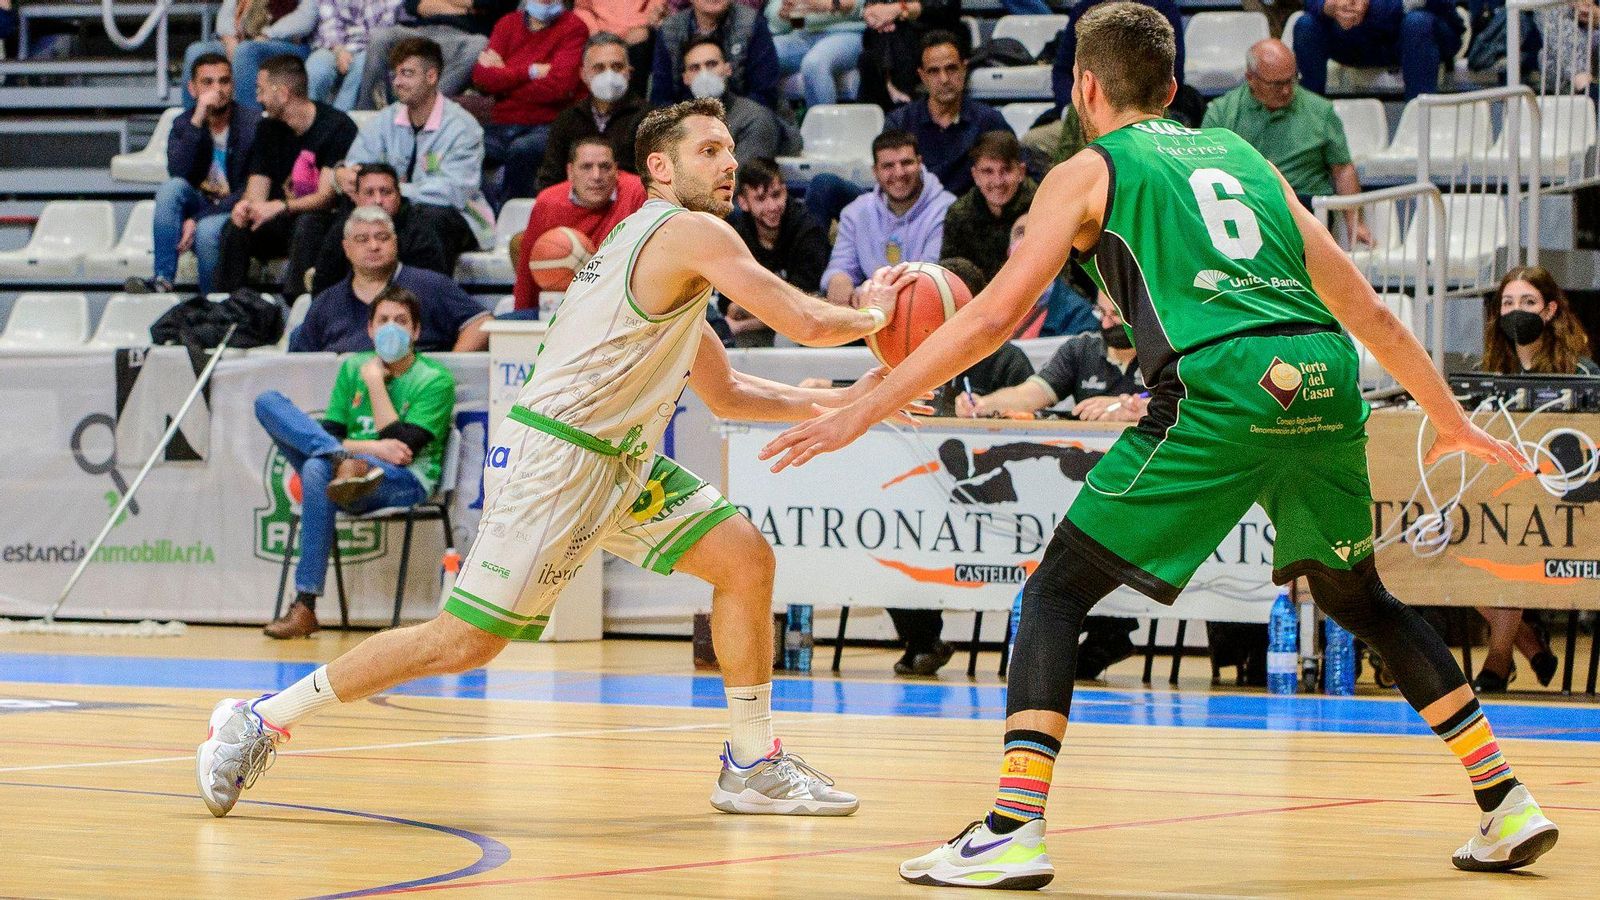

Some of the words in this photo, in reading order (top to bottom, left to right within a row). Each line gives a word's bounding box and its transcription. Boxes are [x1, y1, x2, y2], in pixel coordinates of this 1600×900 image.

[1188, 167, 1264, 260] 6
[500, 363, 537, 386] TA
[1308, 373, 1325, 387] del
[1302, 386, 1335, 401] Casar
[1373, 501, 1585, 548] TRONAT
[955, 565, 1025, 583] CASTELLO
[1545, 560, 1600, 578] CASTEL
